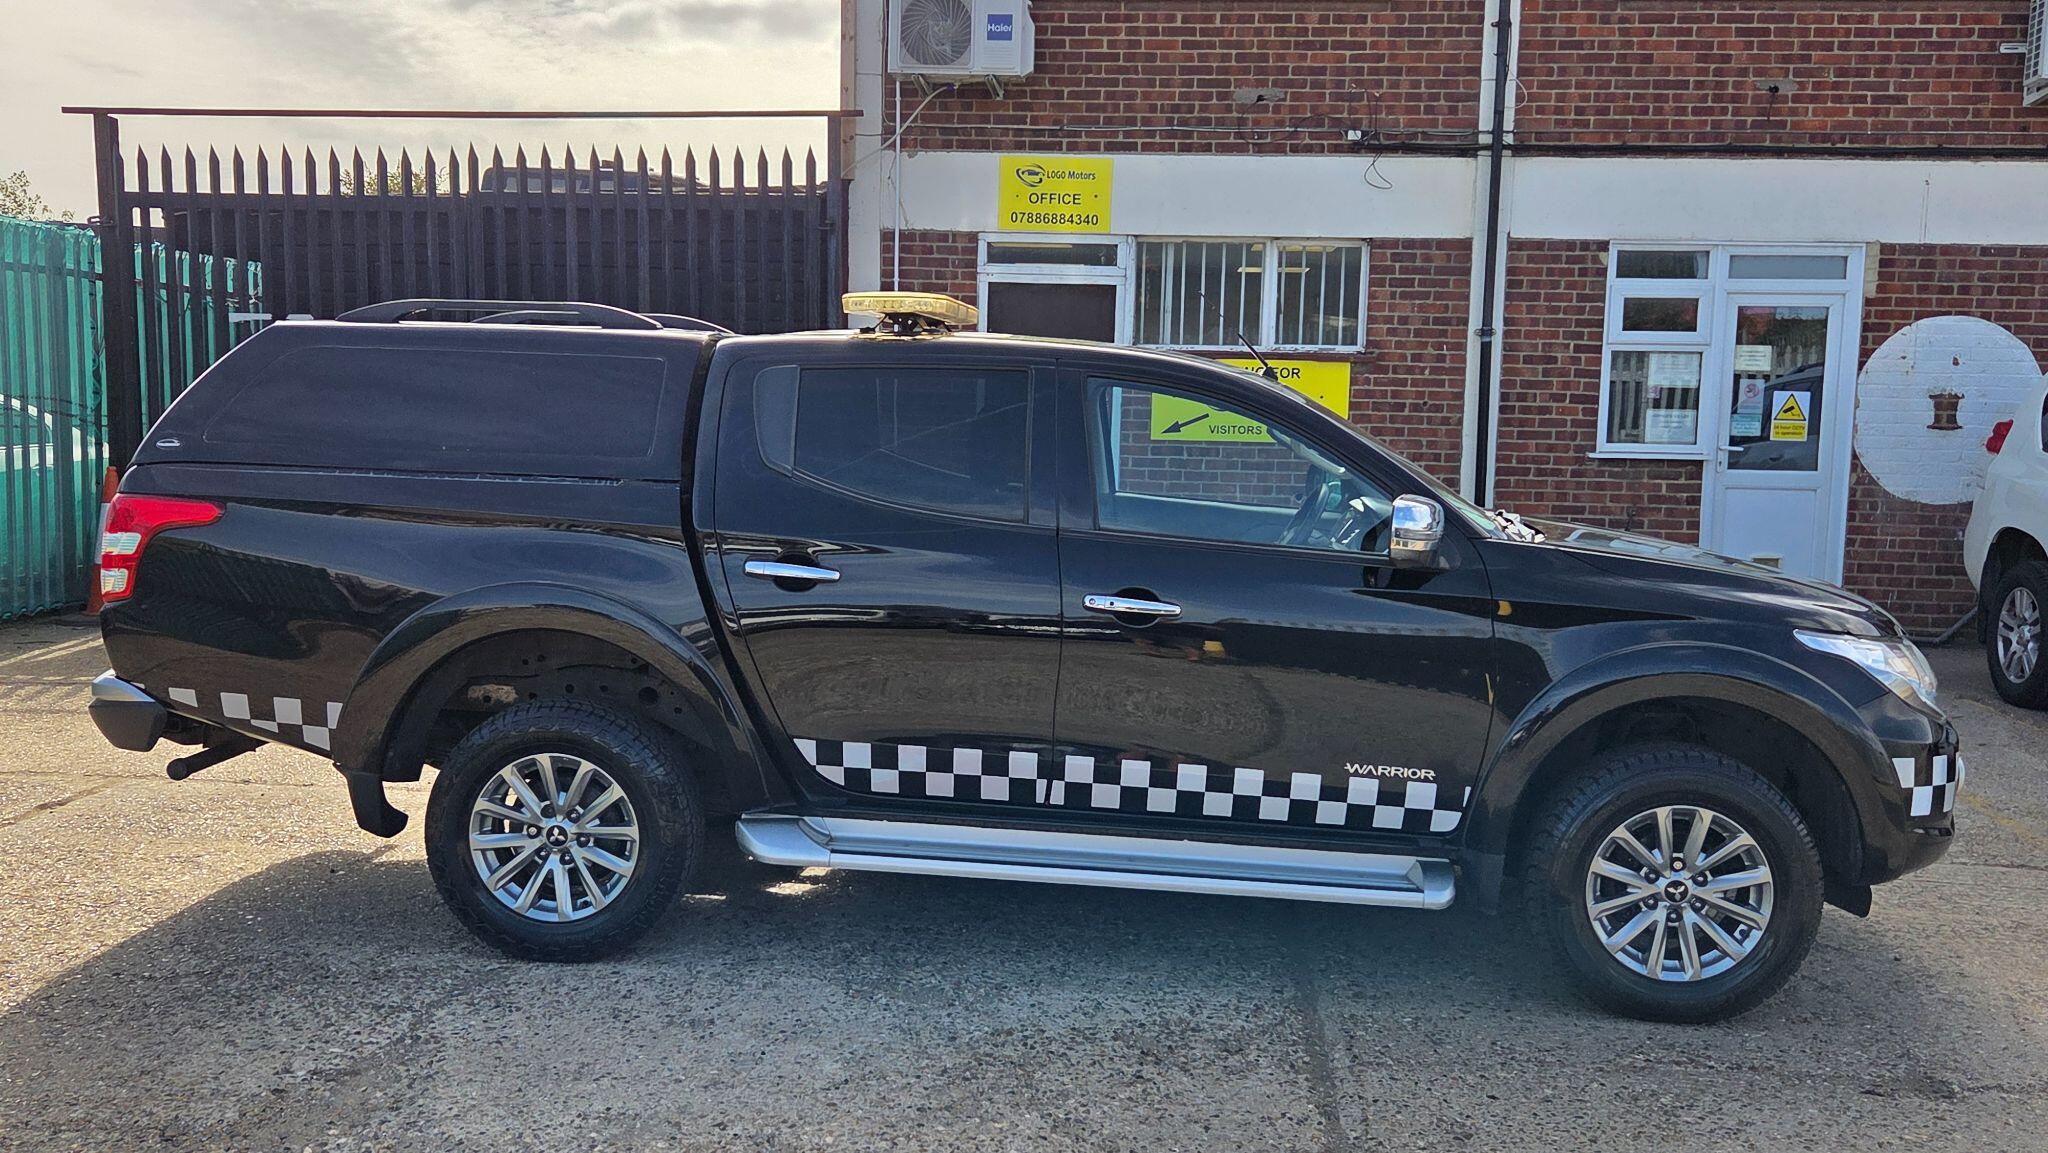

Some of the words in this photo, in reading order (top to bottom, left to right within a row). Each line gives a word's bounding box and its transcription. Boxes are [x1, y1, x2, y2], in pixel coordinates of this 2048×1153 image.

[987, 22, 1013, 33] Haier
[1046, 170, 1066, 180] LOGO
[1067, 170, 1096, 181] Motors
[1028, 192, 1082, 205] OFFICE
[1010, 211, 1099, 226] 07886884340
[1208, 425, 1262, 435] VISITORS
[1344, 762, 1436, 781] WARRIOR
